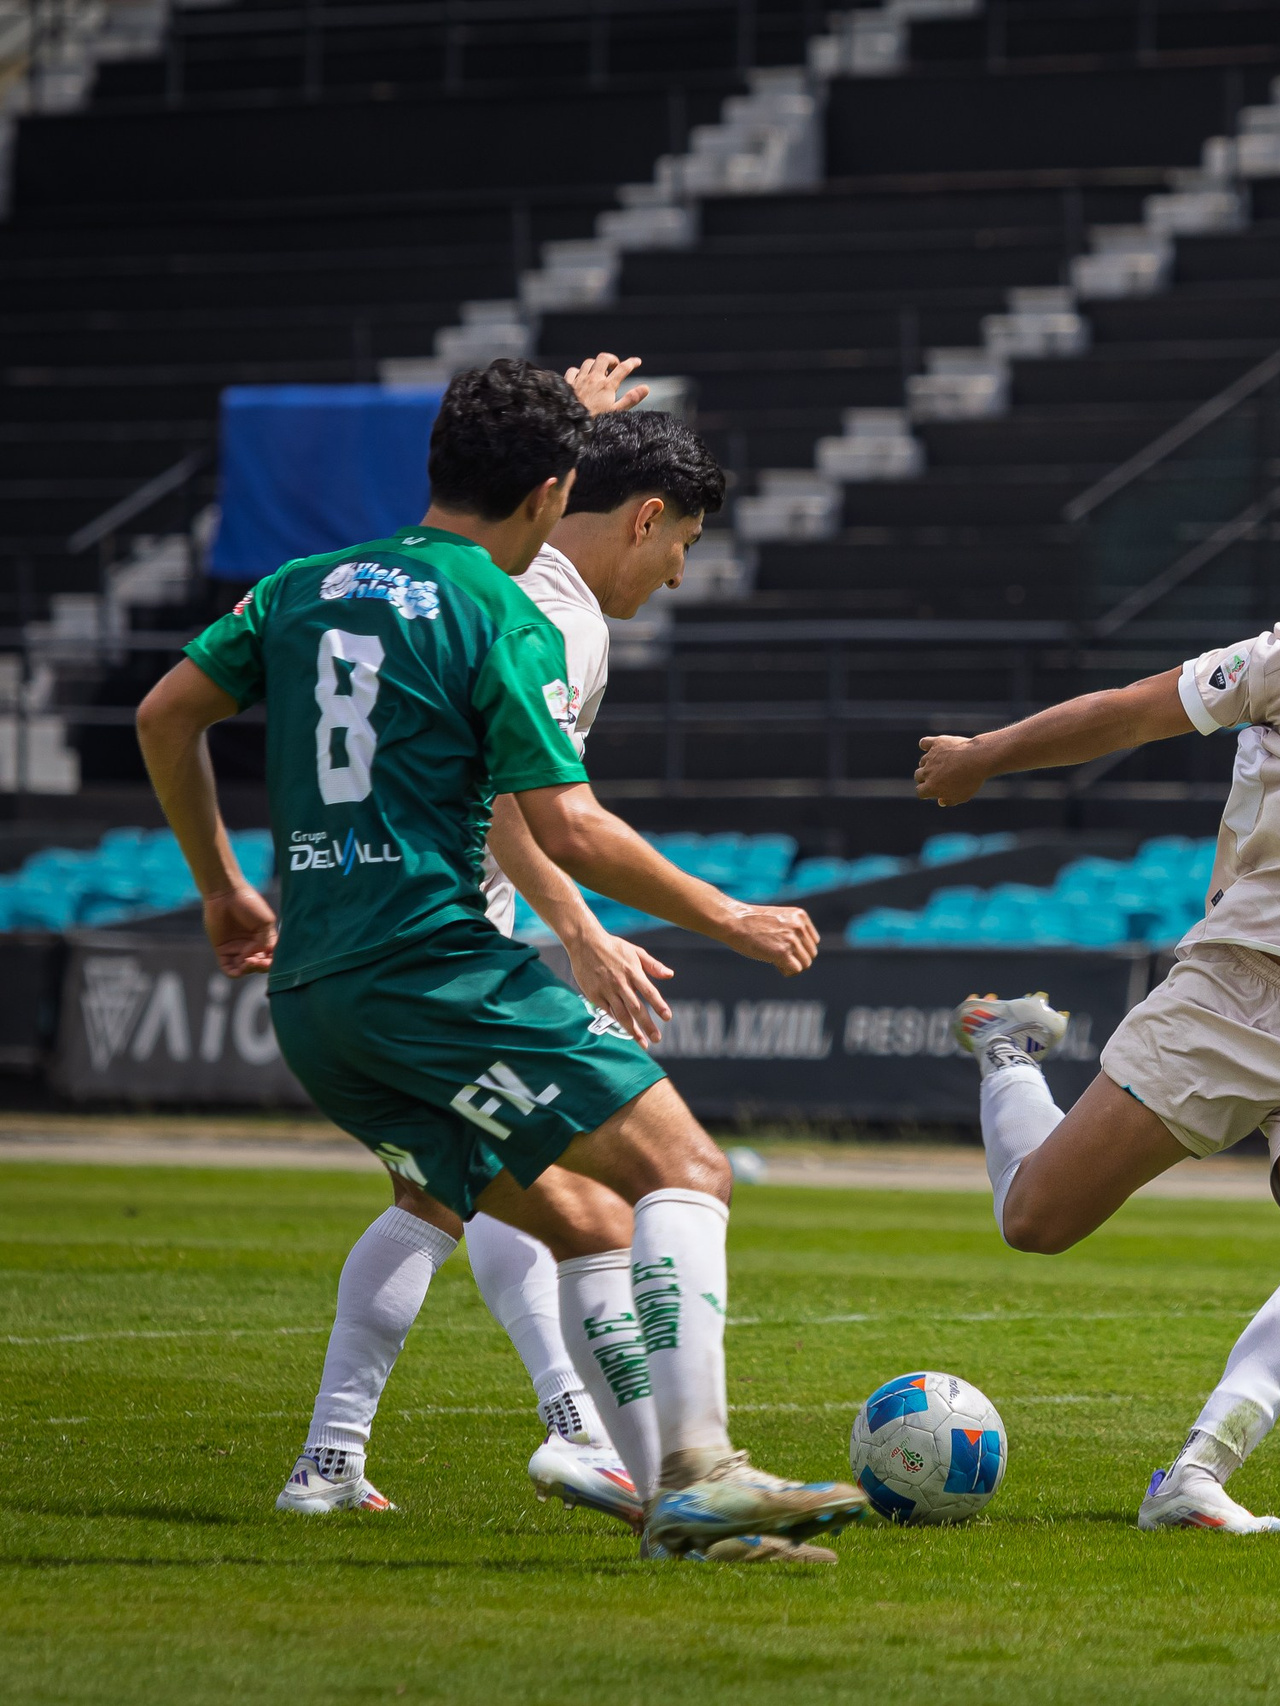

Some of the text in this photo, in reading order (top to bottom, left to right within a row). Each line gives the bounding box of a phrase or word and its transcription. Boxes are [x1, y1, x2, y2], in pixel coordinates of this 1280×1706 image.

[315, 628, 386, 806] 8
[291, 830, 328, 844] Grupo
[632, 1256, 681, 1356] BONFIL FC
[593, 1335, 653, 1409] BONFIL
